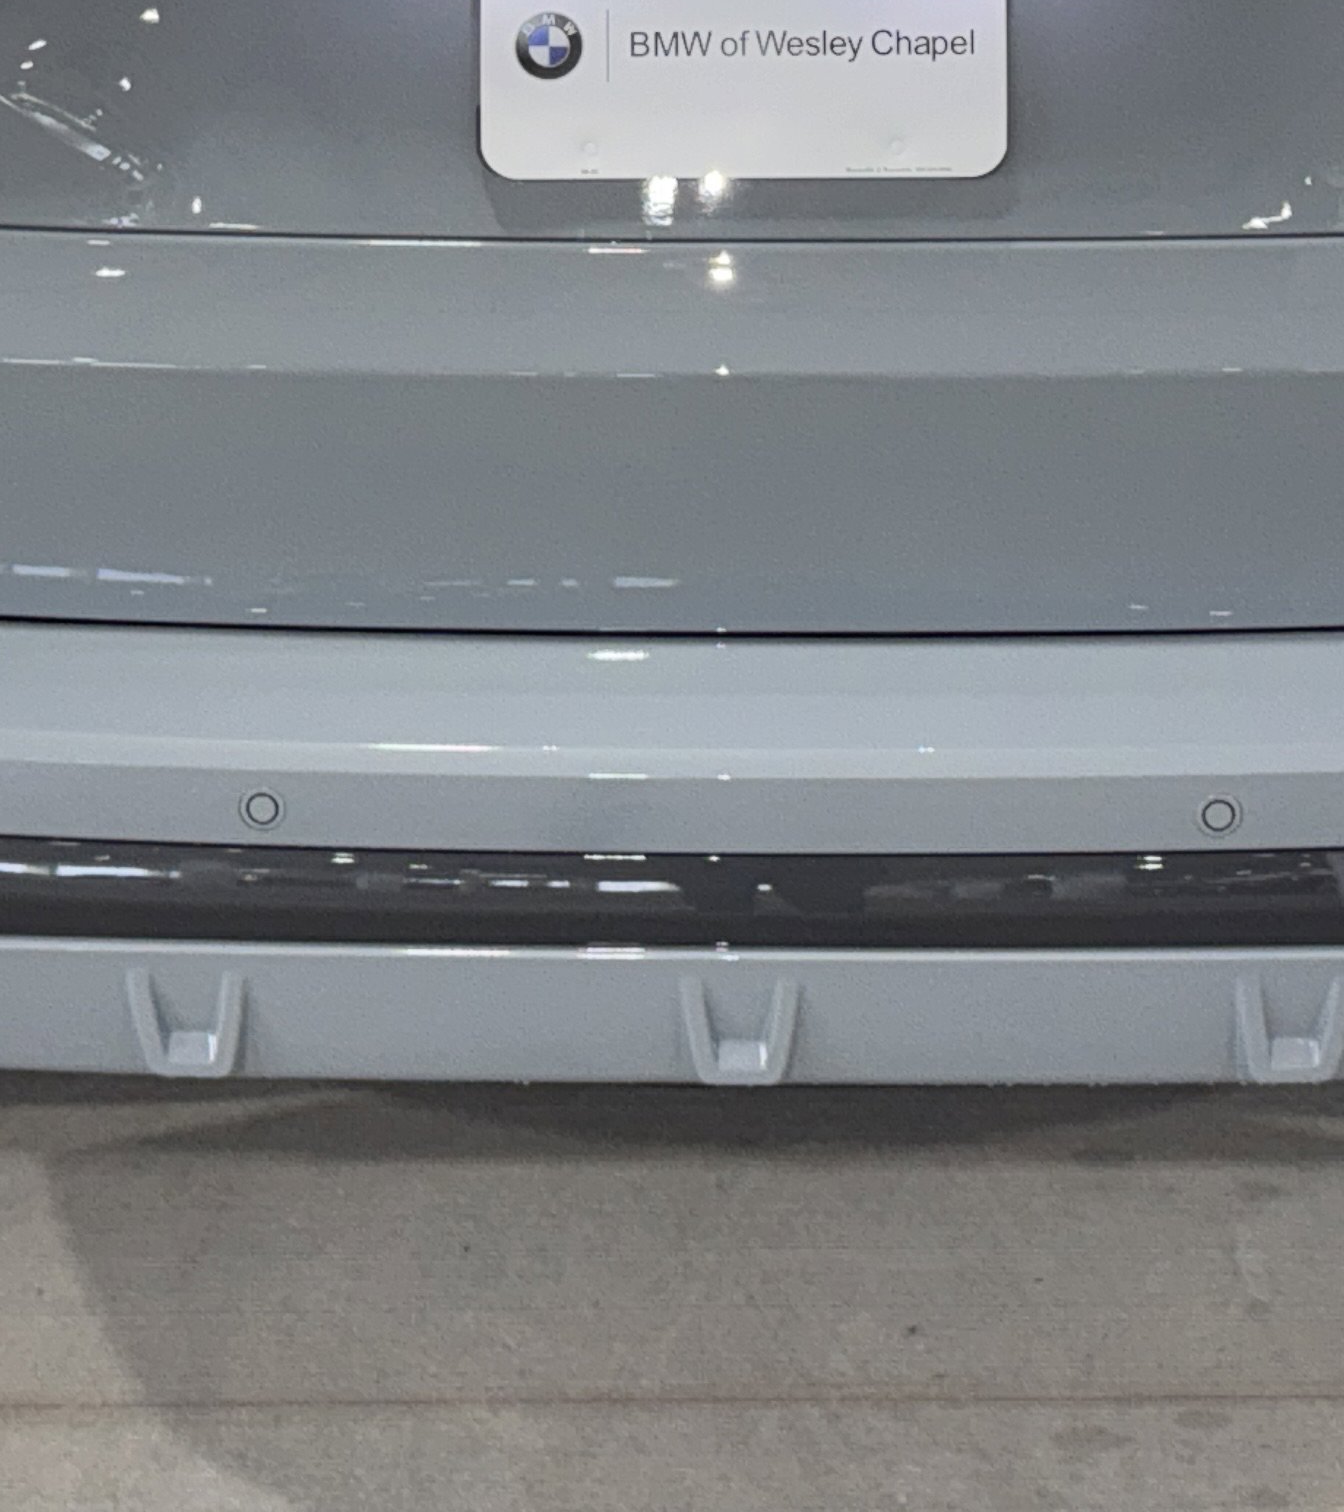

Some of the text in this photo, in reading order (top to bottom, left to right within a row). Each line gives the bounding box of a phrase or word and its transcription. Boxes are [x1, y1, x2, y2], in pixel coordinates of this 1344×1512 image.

[629, 28, 975, 63] BMW of Wesley Chapel
